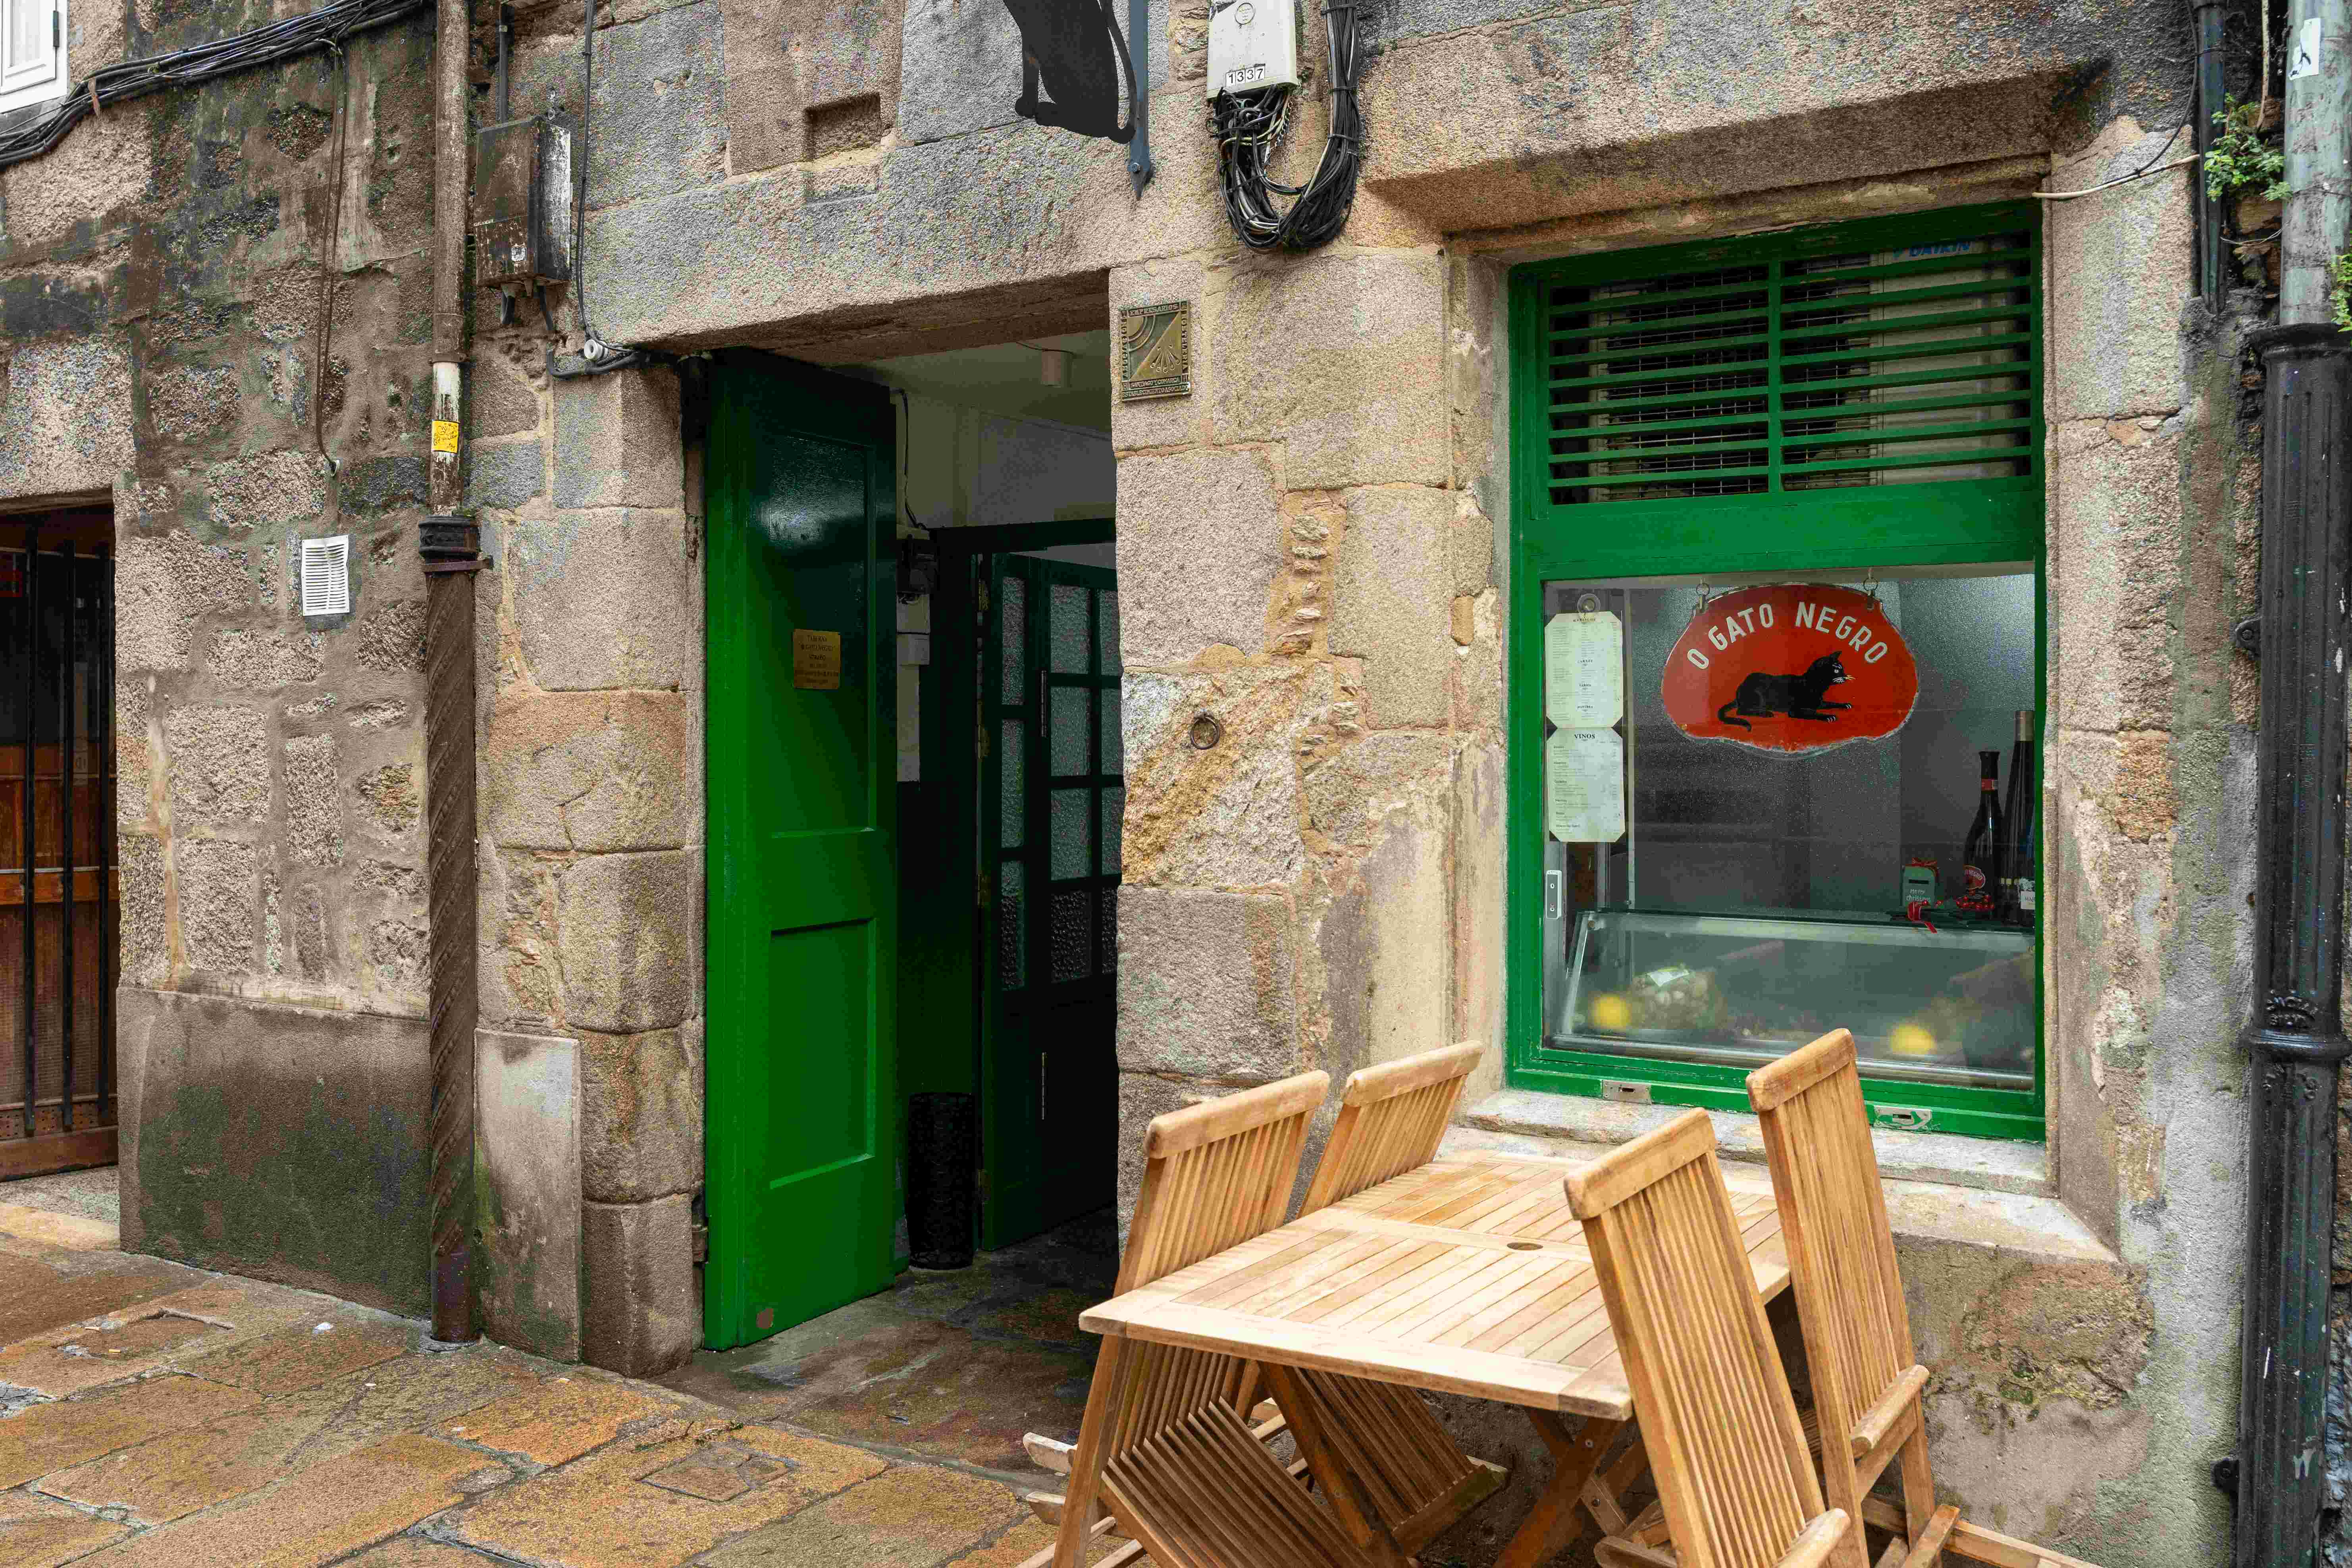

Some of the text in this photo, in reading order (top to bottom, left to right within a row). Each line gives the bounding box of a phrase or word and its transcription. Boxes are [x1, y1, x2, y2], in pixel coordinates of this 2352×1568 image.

[1228, 68, 1264, 84] 1337
[1130, 304, 1177, 315] EMPRESARIOS
[1686, 601, 1888, 670] O GATO NEGRO
